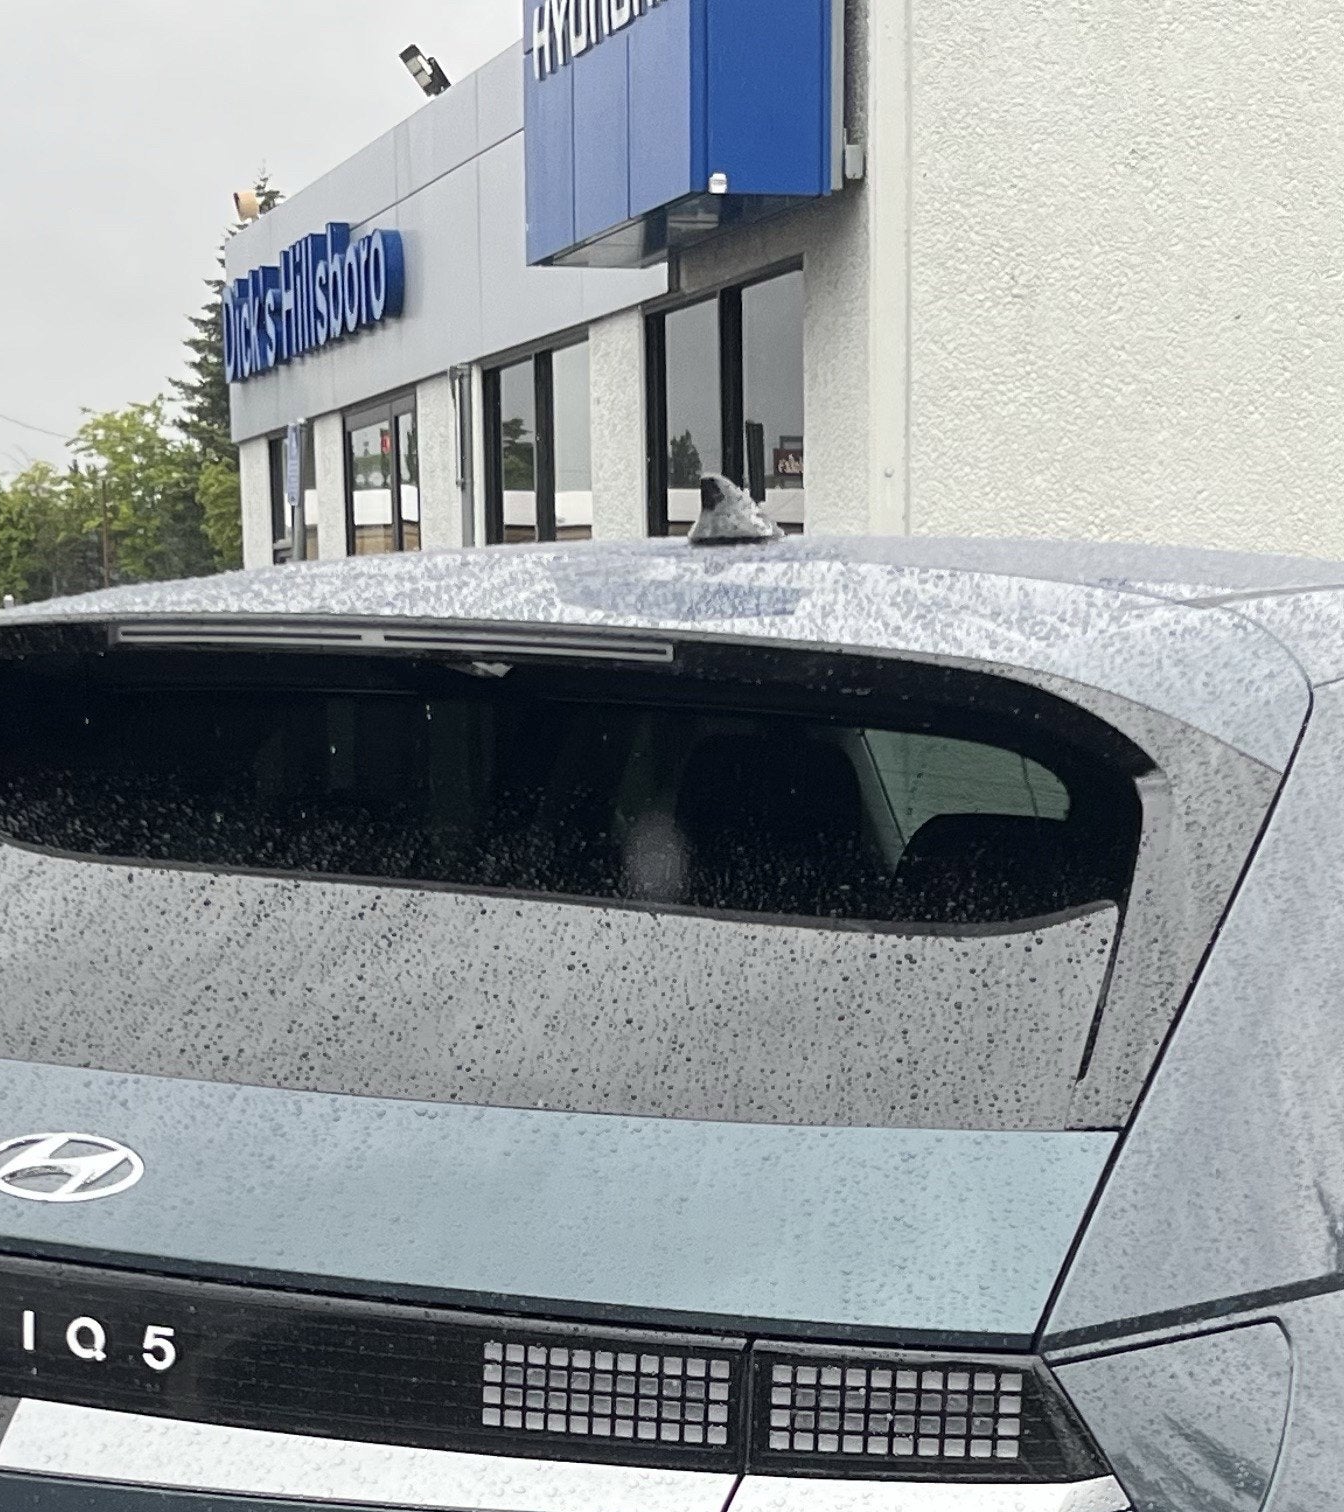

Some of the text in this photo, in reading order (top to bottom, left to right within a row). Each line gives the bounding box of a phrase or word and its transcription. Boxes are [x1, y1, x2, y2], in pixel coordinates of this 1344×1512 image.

[222, 222, 388, 384] Dick's Hillsboro
[142, 1325, 176, 1370] 5
